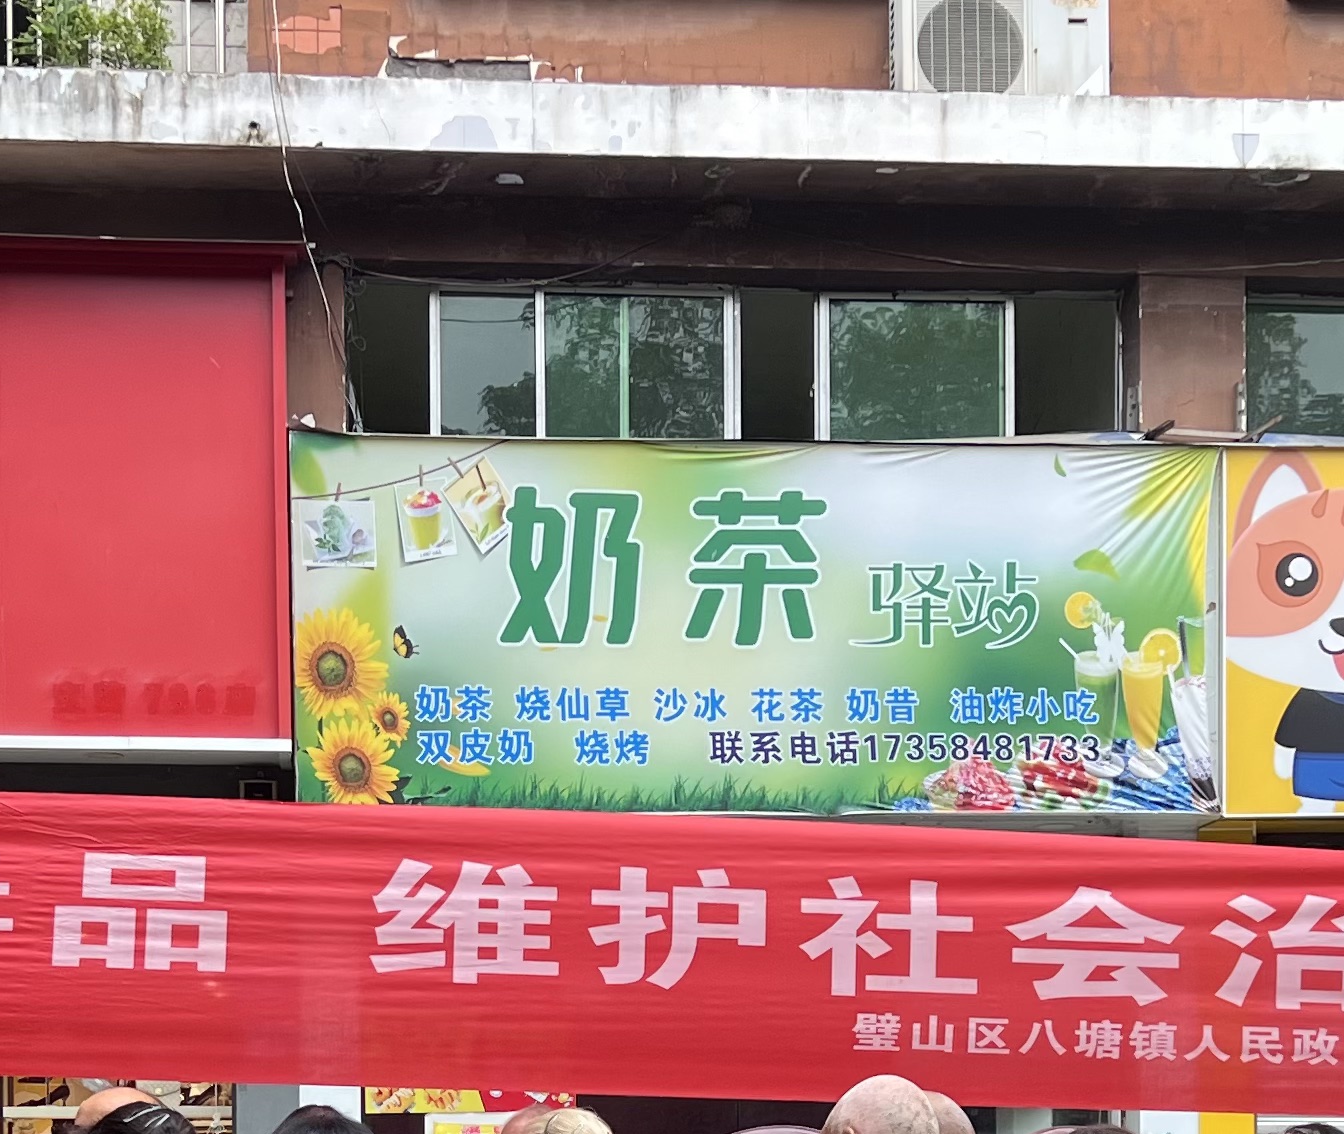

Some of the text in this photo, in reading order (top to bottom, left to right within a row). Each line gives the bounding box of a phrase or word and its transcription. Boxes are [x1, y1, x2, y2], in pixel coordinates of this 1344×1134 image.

[500, 486, 1040, 650] 奶茶 驿站
[415, 686, 1098, 724] 奶茶 烧仙草 沙冰 花茶 奶昔 油炸小吃
[417, 729, 1100, 766] 双皮奶 烧烤 联系电话17358481733
